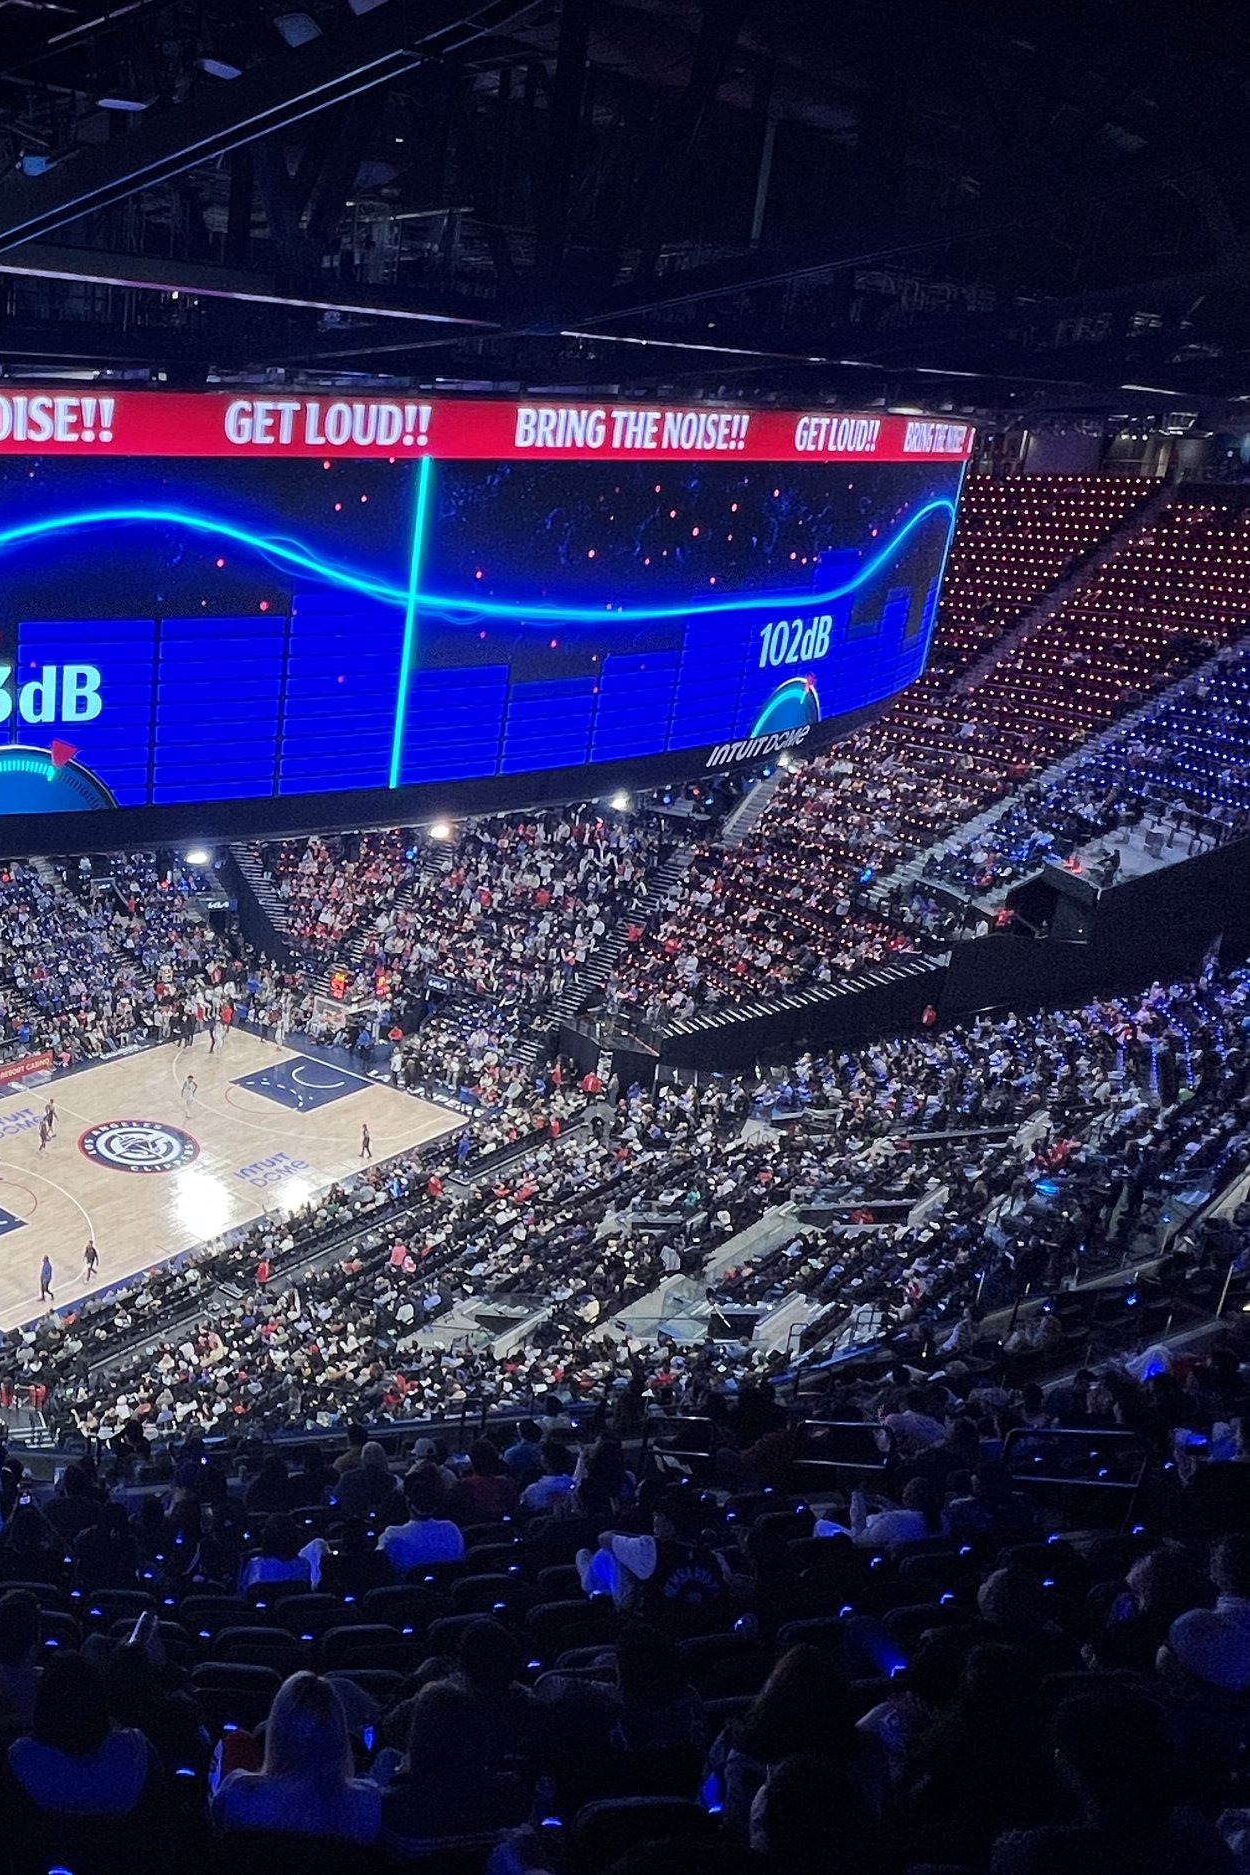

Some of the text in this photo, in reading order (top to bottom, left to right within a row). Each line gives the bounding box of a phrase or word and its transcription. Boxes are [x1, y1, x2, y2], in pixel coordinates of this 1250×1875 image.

[224, 400, 432, 447] GET LOUD!!
[514, 408, 750, 450] BRING THE NOISE!!
[794, 416, 881, 452] GET LOUD!!
[758, 614, 833, 668] 102dB
